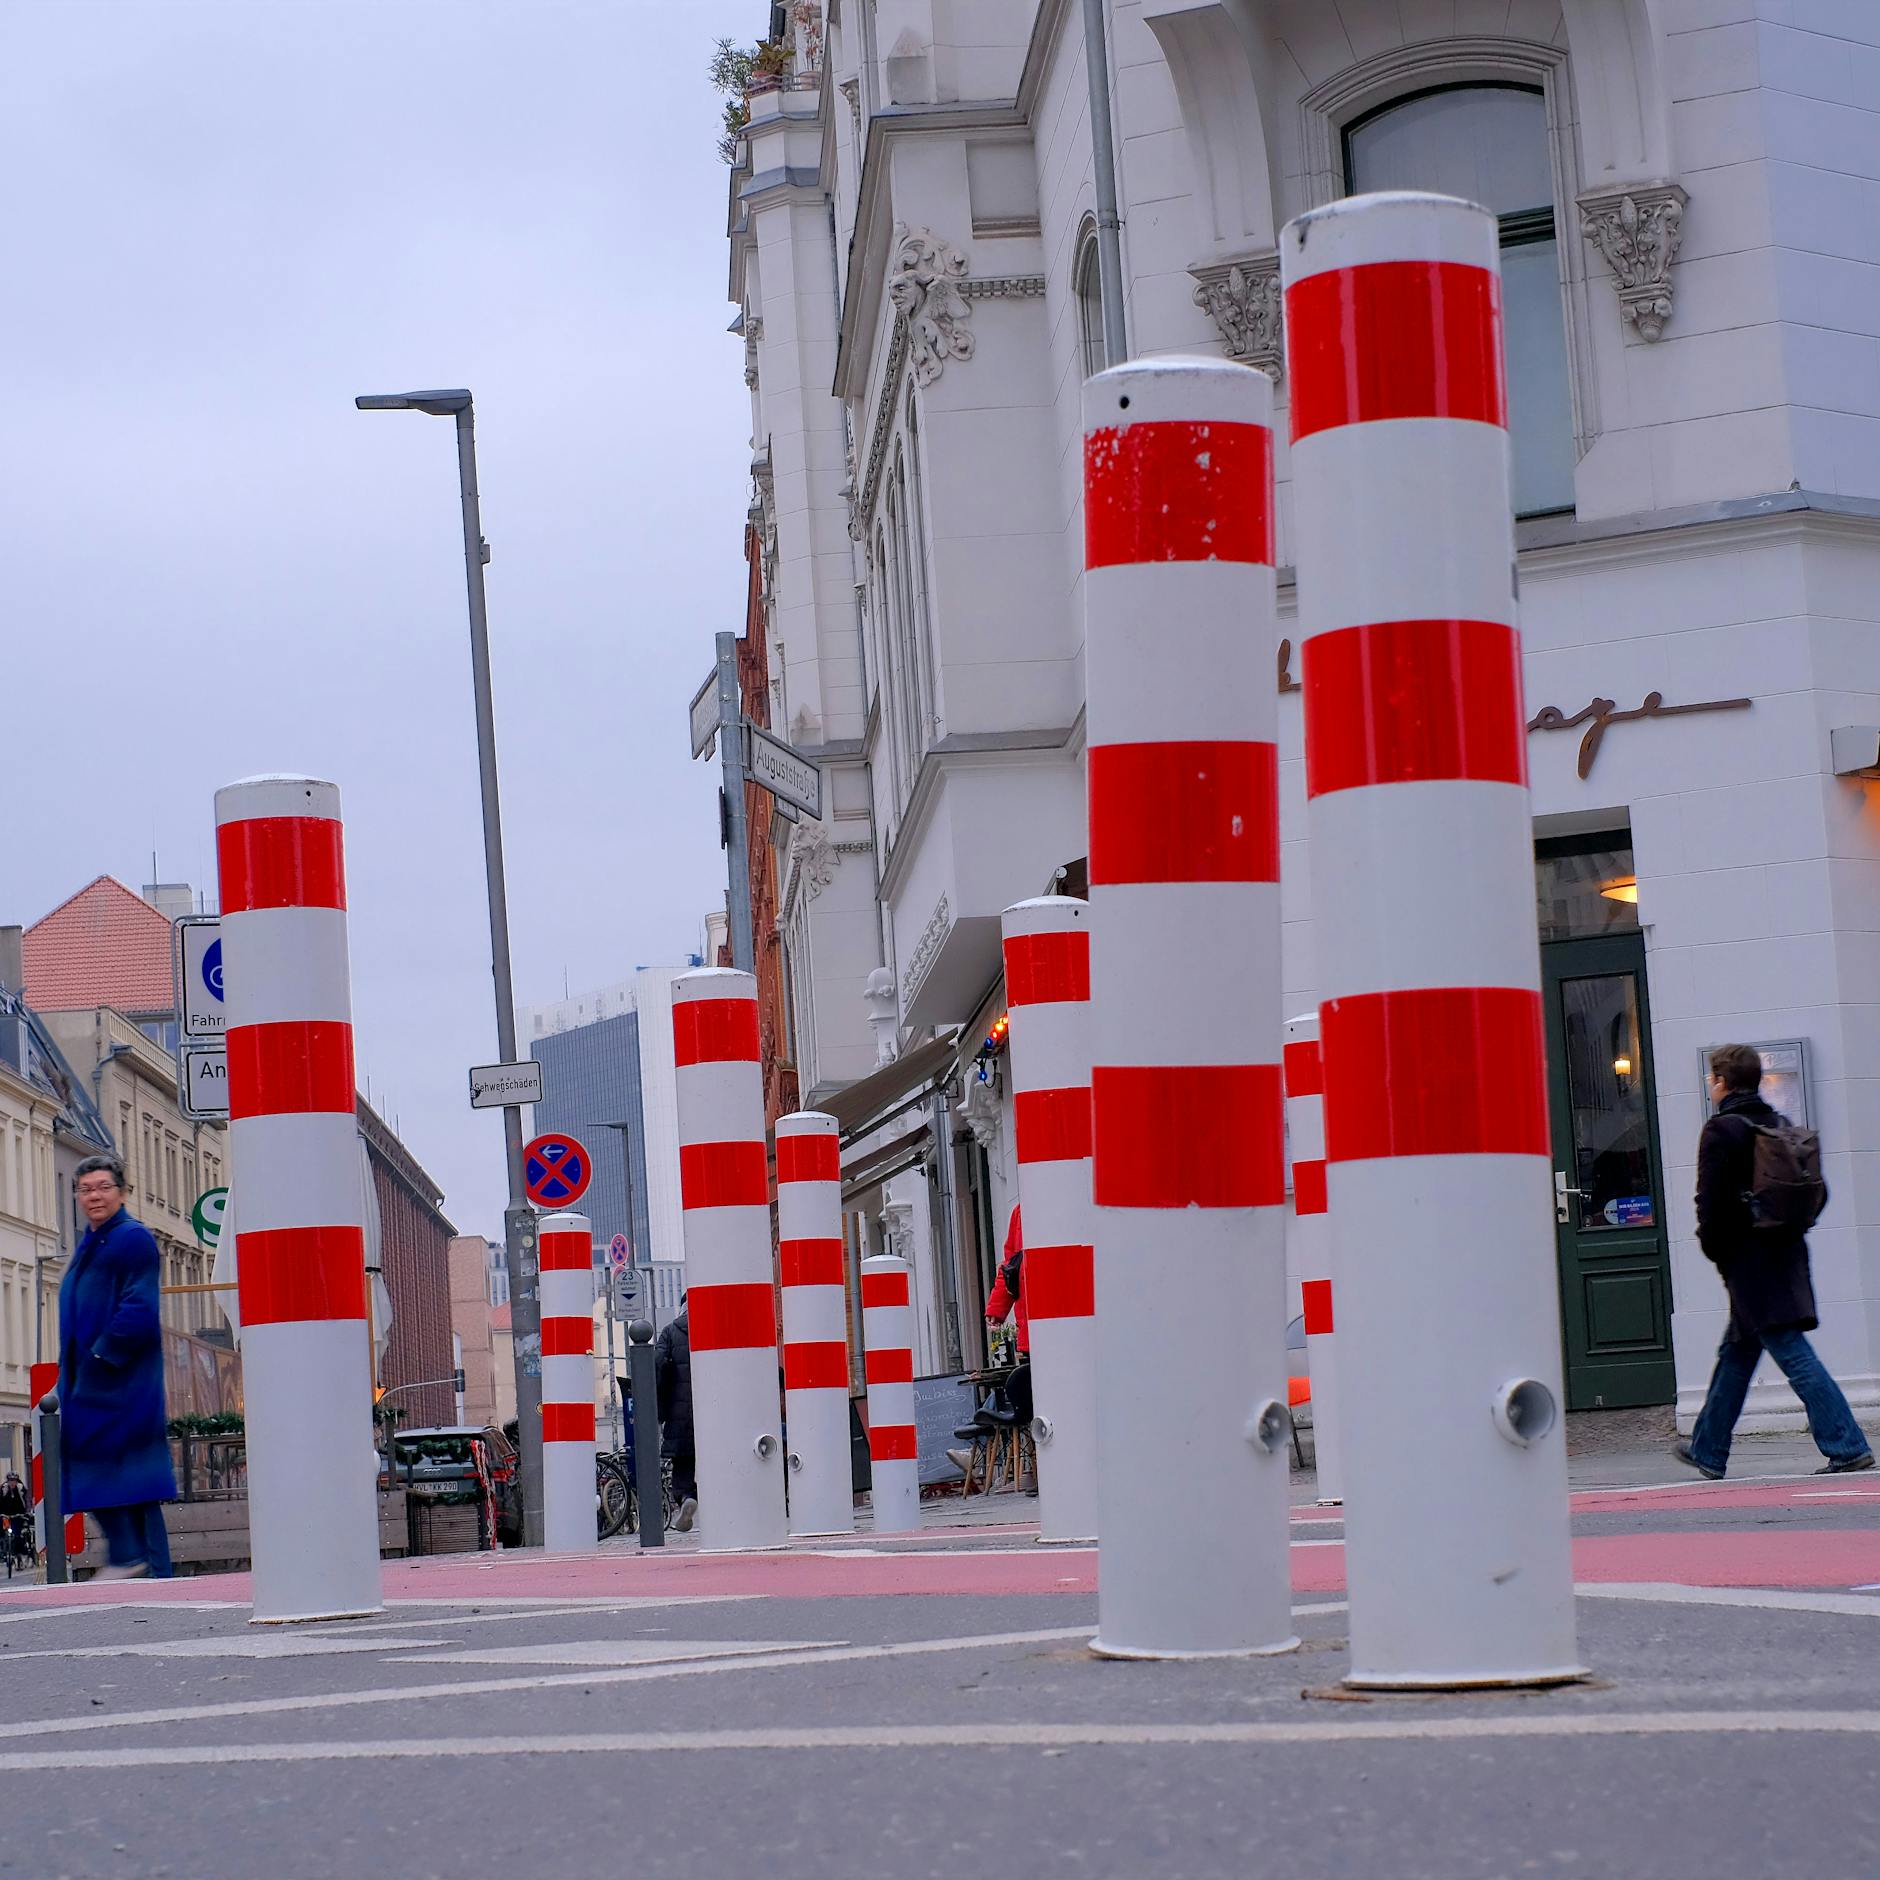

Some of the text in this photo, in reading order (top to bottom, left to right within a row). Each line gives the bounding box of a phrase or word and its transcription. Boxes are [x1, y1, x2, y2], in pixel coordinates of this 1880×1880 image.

[757, 742, 816, 800] Auguststraße
[191, 1014, 226, 1026] Fahr
[621, 1271, 634, 1281] 23
